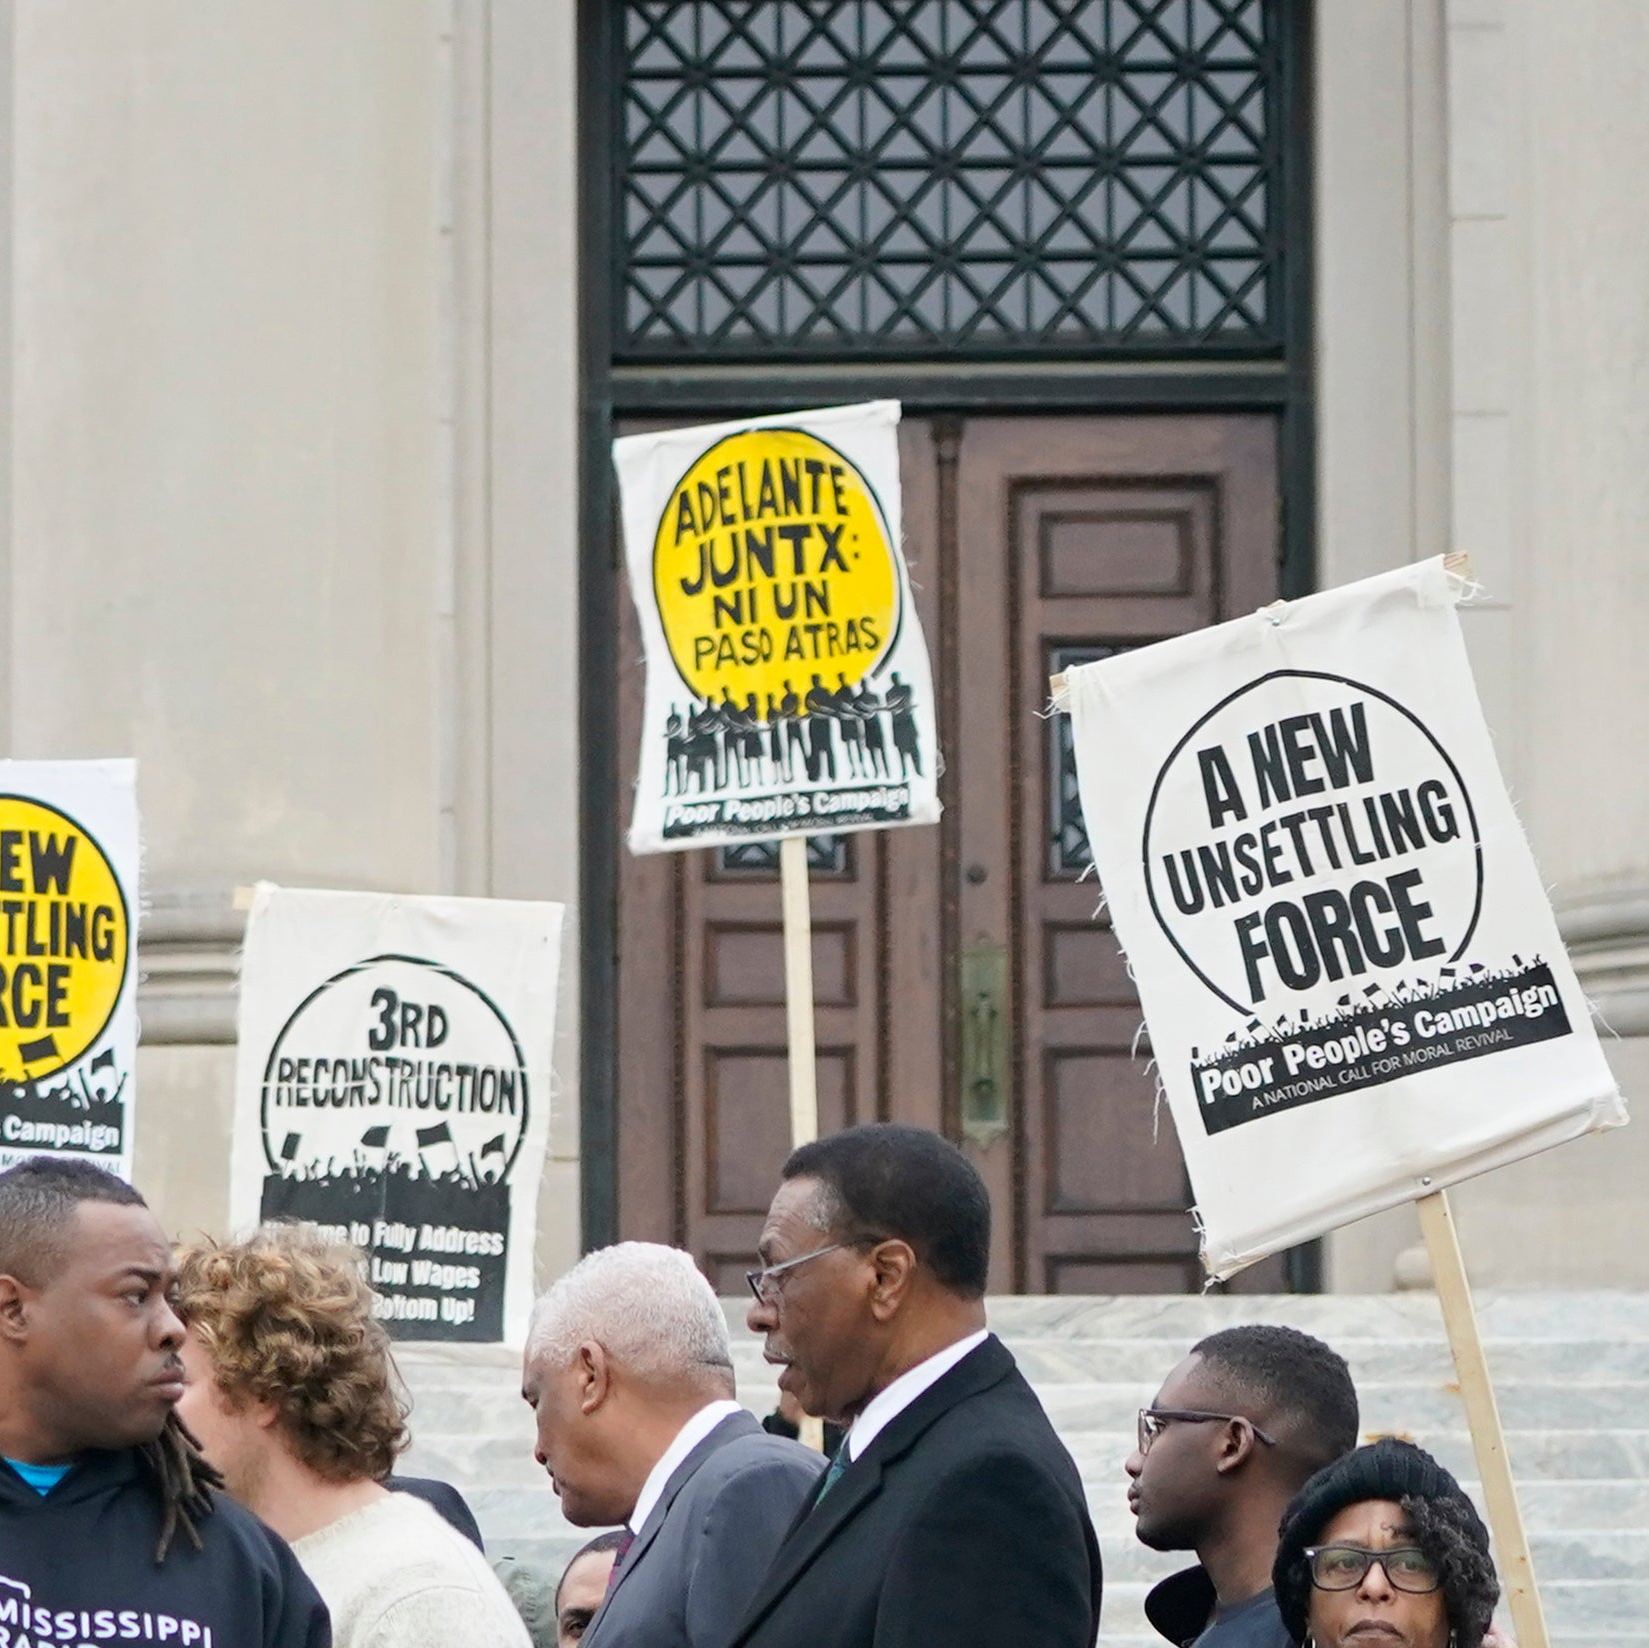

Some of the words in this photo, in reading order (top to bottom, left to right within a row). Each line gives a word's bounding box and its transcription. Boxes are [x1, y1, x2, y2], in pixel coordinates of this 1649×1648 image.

[674, 457, 849, 547] ADELANTE
[714, 586, 758, 629] NI
[773, 579, 831, 621] UN
[693, 627, 773, 671] PASO
[783, 616, 880, 661] ATRAS
[1197, 744, 1248, 829] A
[1247, 701, 1375, 811] NEW
[666, 801, 720, 828] Poor
[722, 793, 811, 822] People's
[1162, 779, 1460, 915] UNSETTLING
[1233, 868, 1446, 1004] FORCE
[368, 985, 448, 1051] 3RD
[1199, 1060, 1275, 1104] Poor
[1282, 1019, 1410, 1076] People's
[1413, 985, 1559, 1039] Campaign
[276, 1056, 516, 1115] RECONSTRUCTION
[1251, 1095, 1266, 1110] A
[1263, 1074, 1336, 1107] NATIONAL
[1339, 1064, 1371, 1085] CALL
[1372, 1056, 1401, 1075] FOR
[1402, 1042, 1454, 1067] MORAL
[1455, 1028, 1514, 1053] REVIVAL
[2, 1114, 119, 1151] Campaign
[349, 1220, 371, 1247] to
[373, 1221, 417, 1254] Fully
[418, 1222, 504, 1257] Address
[371, 1256, 408, 1286] Low
[411, 1258, 481, 1291] Wages
[440, 1297, 476, 1325] Up!
